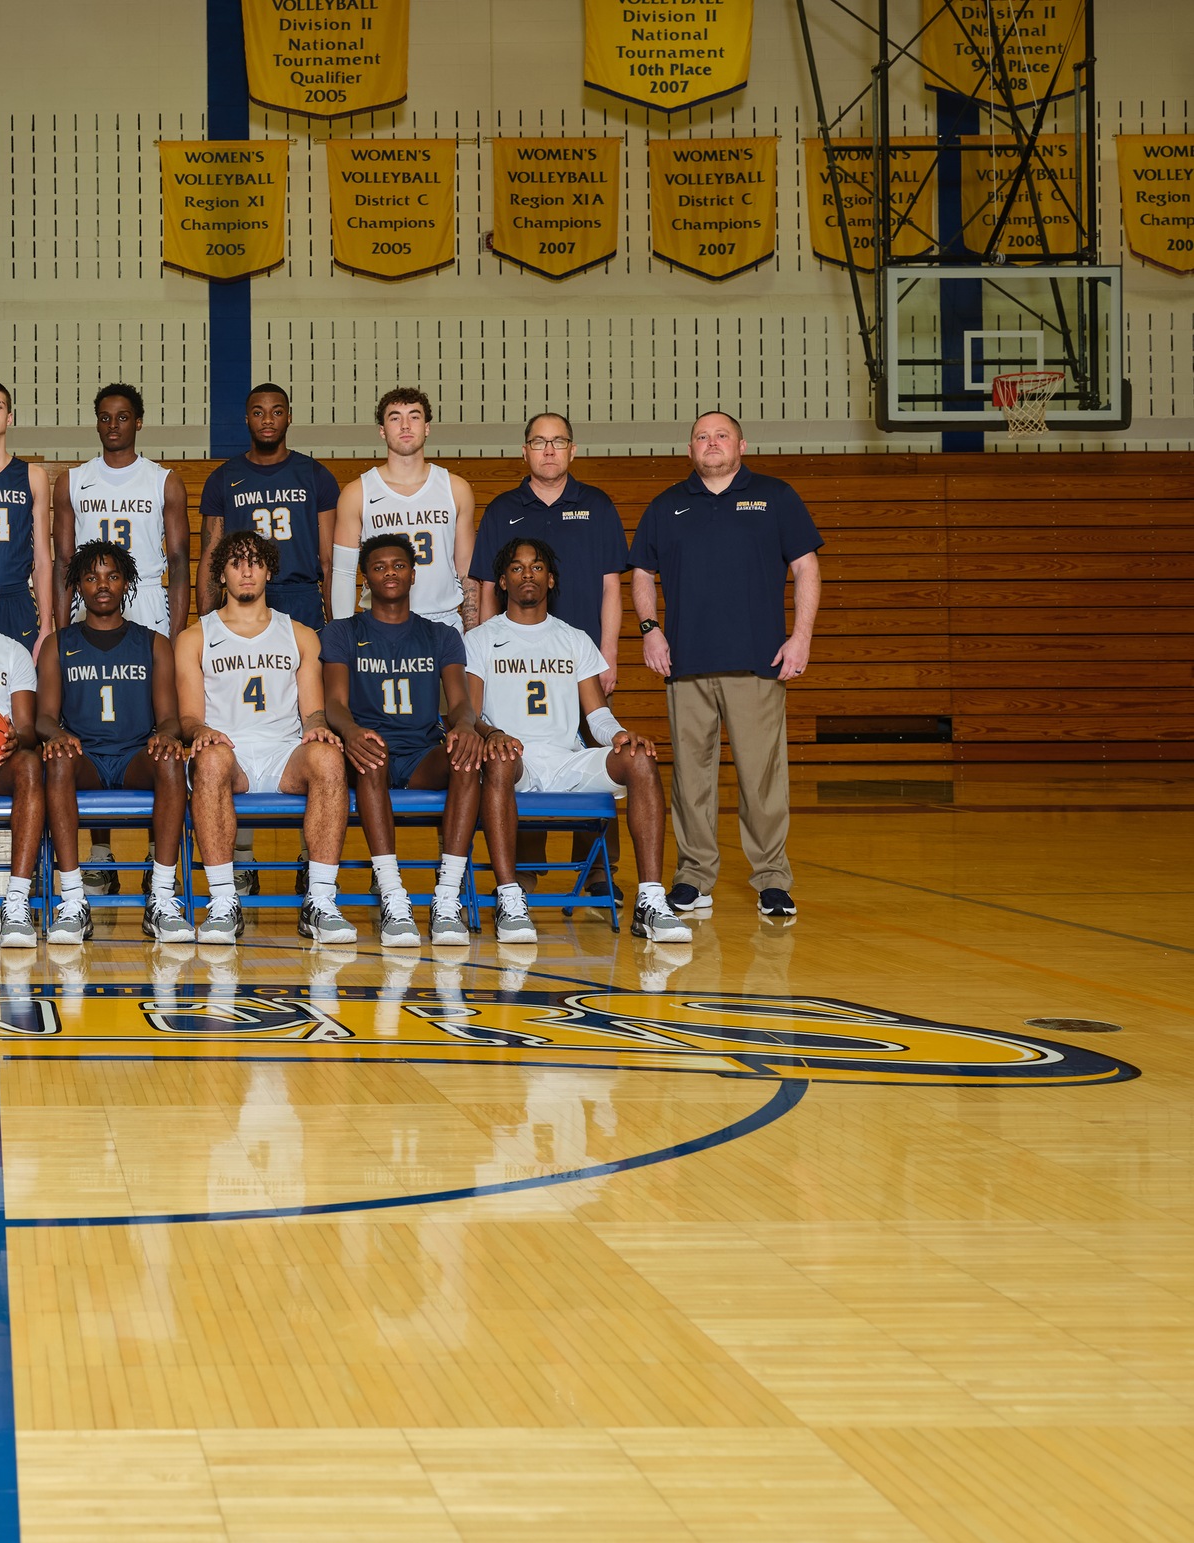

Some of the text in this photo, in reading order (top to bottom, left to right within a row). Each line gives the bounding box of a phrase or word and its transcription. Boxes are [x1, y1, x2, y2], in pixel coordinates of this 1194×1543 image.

[273, 0, 379, 11] VOLLEYBALL
[1044, 6, 1056, 18] II
[623, 9, 717, 23] Division II
[279, 17, 372, 31] Division II
[631, 28, 708, 41] National
[289, 38, 364, 51] National
[616, 46, 725, 59] Tournament
[273, 54, 381, 67] Tournament
[1009, 60, 1050, 73] Place
[629, 64, 712, 76] 10th Place
[290, 71, 362, 86] Qualifier
[650, 81, 689, 93] 2007
[305, 90, 346, 103] 2005
[185, 151, 265, 163] WOMEN'S
[351, 150, 431, 161] WOMEN'S
[517, 149, 597, 161] WOMEN'S
[673, 149, 754, 162] WOMEN'S
[174, 173, 275, 186] VOLLEYBALL
[341, 171, 441, 184] VOLLEYBALL
[507, 171, 608, 184] VOLLEYBALL
[664, 171, 765, 186] VOLLEYBALL
[184, 195, 264, 211] Region XI
[355, 194, 429, 206] District C
[510, 194, 564, 208] Region
[678, 193, 753, 207] District C
[1136, 192, 1190, 206] Region
[181, 219, 269, 234] Champions
[347, 217, 435, 232] Champions
[513, 217, 602, 232] Champions
[672, 218, 761, 233] Champions
[206, 244, 246, 256] 2005
[371, 242, 412, 255] 2005
[539, 242, 576, 254] 2007
[698, 243, 736, 256] 2007
[234, 489, 306, 507] IOWA LAKES
[80, 500, 152, 513] IOWA LAKES
[252, 507, 292, 541] 33
[372, 511, 449, 529] IOWA LAKES
[98, 518, 132, 552] 13
[212, 654, 292, 673] IOWA LAKES
[357, 657, 434, 673] IOWA LAKES
[494, 658, 574, 675] IOWA LAKES
[68, 664, 147, 682] IOWA LAKES
[242, 675, 266, 712] 4
[382, 678, 413, 715] 11
[526, 680, 548, 716] 2
[100, 685, 115, 722] 1
